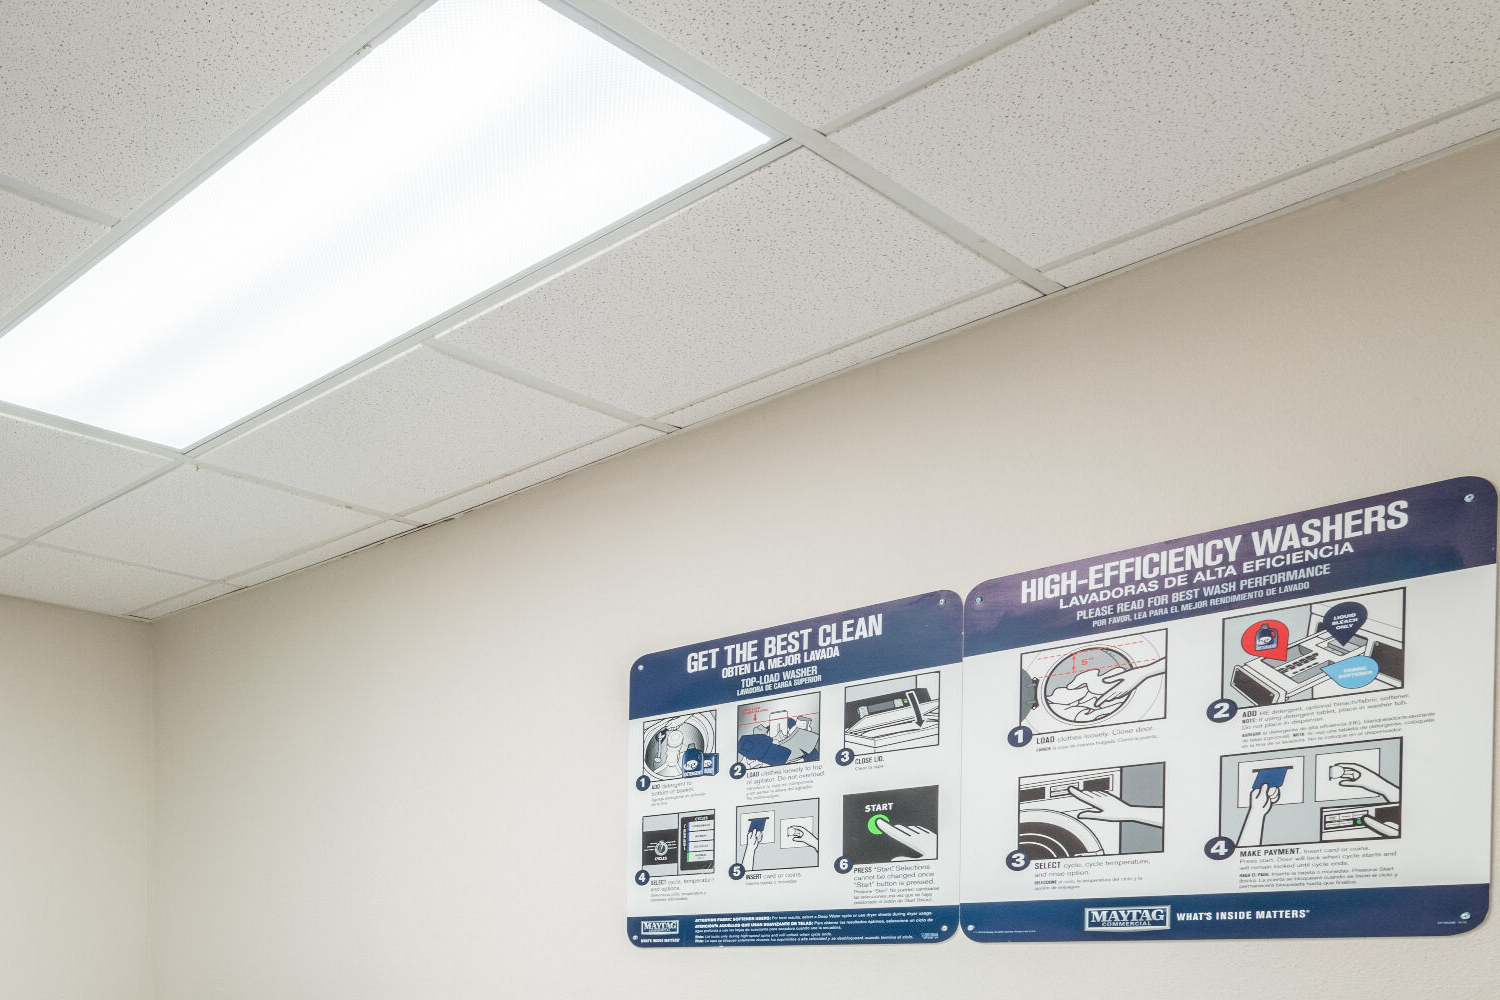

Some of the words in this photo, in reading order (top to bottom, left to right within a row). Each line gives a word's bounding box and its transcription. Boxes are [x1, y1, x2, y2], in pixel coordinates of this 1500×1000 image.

[1021, 535, 1242, 604] HIGH-EFFICIENCY
[1251, 500, 1409, 556] WASHERS
[1059, 580, 1159, 609] LAVADORAS
[1165, 574, 1188, 588] DE
[1193, 566, 1237, 583] ALTA
[1243, 542, 1354, 574] EFICIENCIA
[1077, 606, 1114, 620] PLEASE
[1117, 599, 1145, 614] READ
[1147, 595, 1169, 608] FOR
[1172, 588, 1200, 603] BEST
[1203, 580, 1236, 597] WASH
[1240, 564, 1331, 591] PERFORMANCE
[1092, 618, 1106, 627] POR
[1108, 614, 1132, 626] FAVOR,
[1134, 612, 1147, 620] LEA
[1149, 608, 1168, 617] PARA
[1181, 600, 1208, 611] MEJOR
[1210, 590, 1264, 606] RENDIMIENTO
[1266, 587, 1277, 596] DE
[1278, 581, 1310, 594] LAVADO
[687, 648, 719, 674] GET
[724, 640, 757, 666] THE
[764, 628, 812, 658] BEST
[819, 614, 882, 648] CLEAN
[722, 663, 750, 679] OBTEN
[754, 660, 765, 673] LA
[768, 653, 800, 670] MEJOR
[804, 646, 840, 663] LAVADA
[741, 672, 780, 688] TOP-LOAD
[783, 666, 817, 681] WASHER
[737, 685, 763, 696] LAVADORA
[774, 680, 792, 690] CARGA
[794, 675, 821, 686] SUPERIOR
[1214, 703, 1230, 718] 2
[1014, 729, 1024, 743] 1
[1036, 736, 1055, 744] LOAD
[841, 751, 849, 762] 3
[734, 767, 742, 776] 2
[640, 778, 645, 787] 1
[865, 803, 894, 812] START
[1210, 840, 1228, 856] 4
[840, 859, 848, 870] 6
[1011, 853, 1025, 868] 3
[639, 873, 646, 882] 4
[733, 866, 740, 876] 5
[1090, 909, 1164, 923] MAYTAG
[1176, 912, 1212, 921] WHAT'S
[1216, 911, 1252, 920] INSIDE
[1256, 910, 1306, 919] MATTERS
